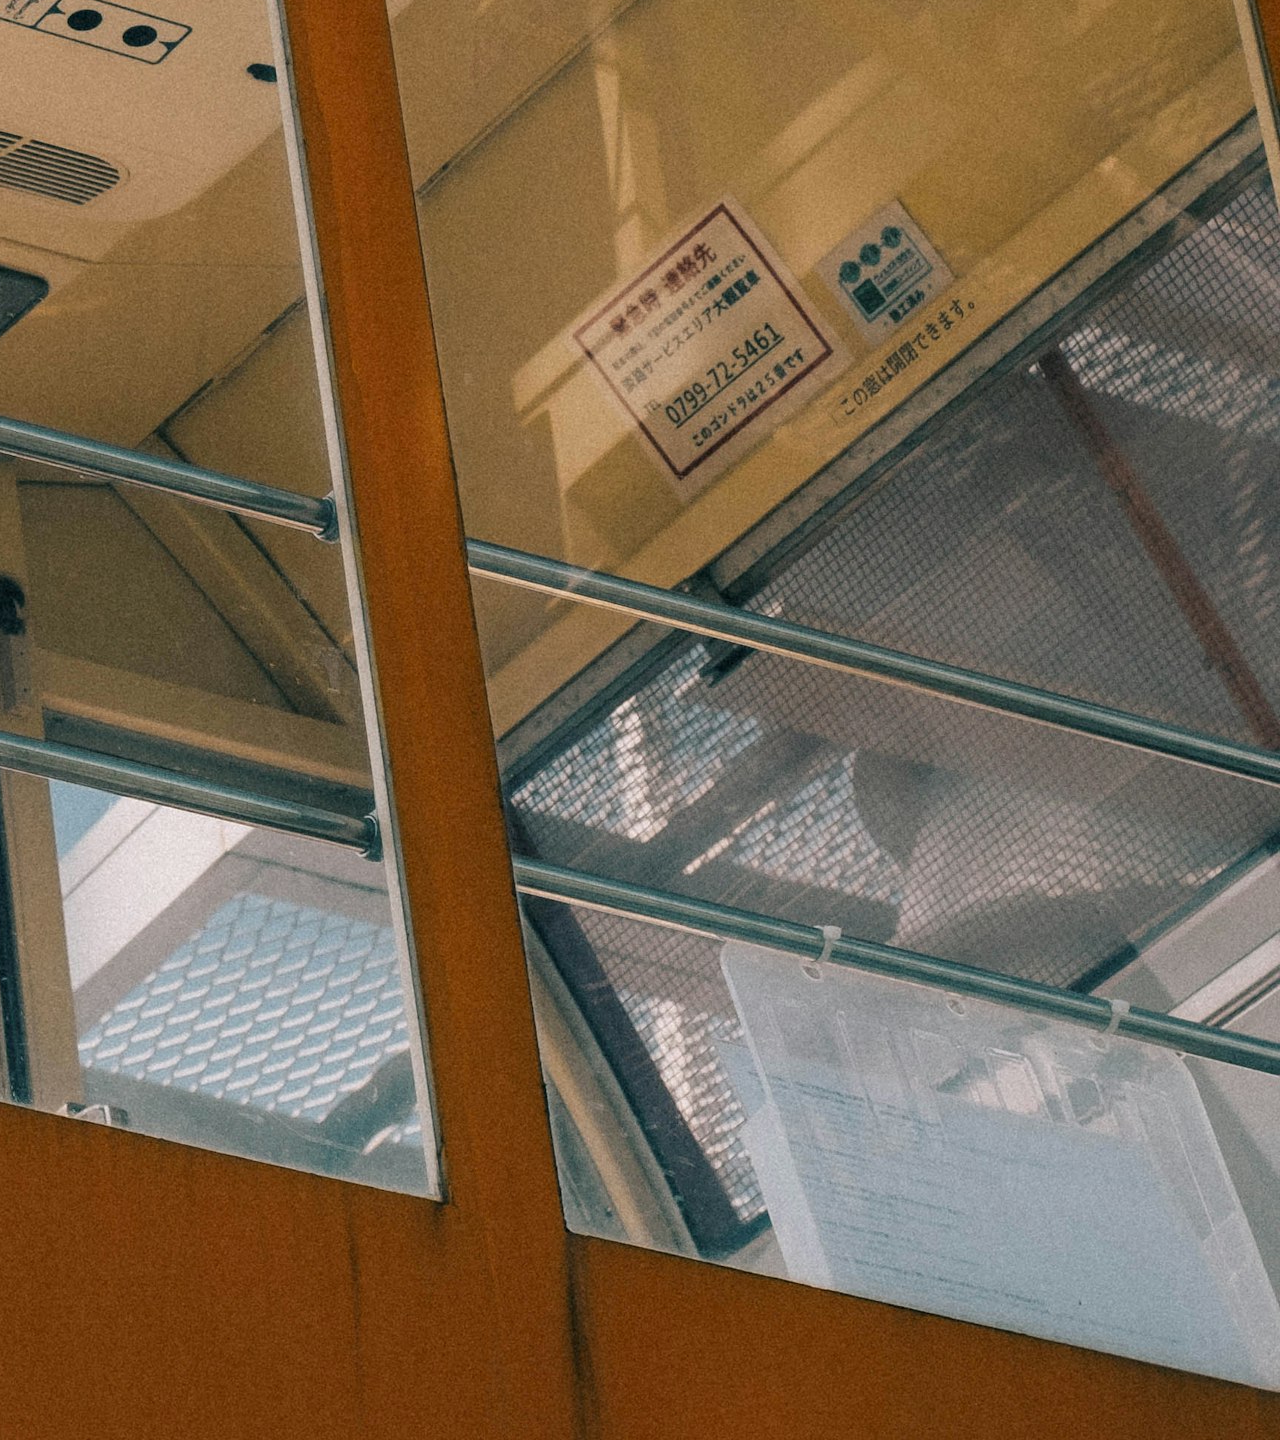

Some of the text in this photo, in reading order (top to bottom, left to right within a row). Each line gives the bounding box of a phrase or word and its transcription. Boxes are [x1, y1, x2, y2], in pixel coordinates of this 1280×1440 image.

[661, 242, 718, 294] 連絡先
[664, 322, 784, 426] 0799-72-5461
[840, 298, 976, 417] この窓は開閉できます。
